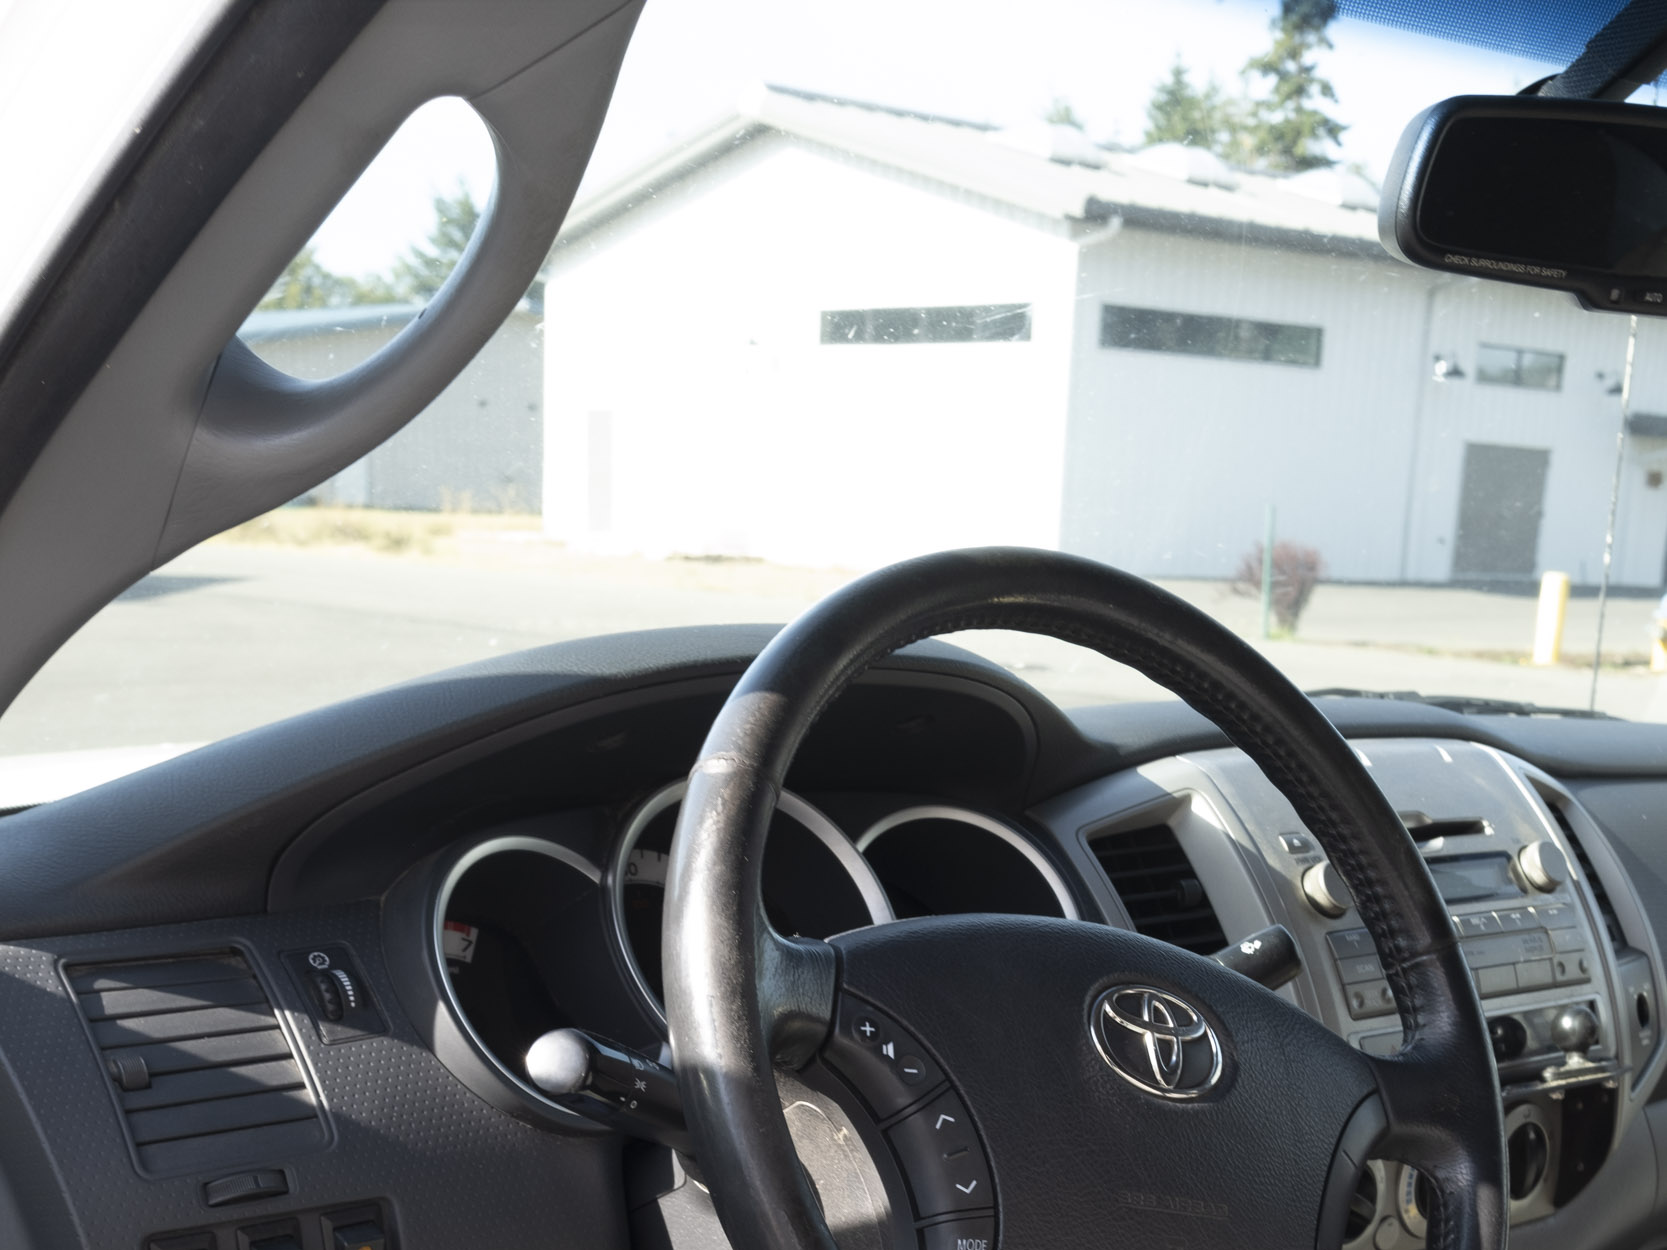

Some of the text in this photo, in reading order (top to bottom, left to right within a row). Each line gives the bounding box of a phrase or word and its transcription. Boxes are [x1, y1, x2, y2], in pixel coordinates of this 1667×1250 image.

[1444, 254, 1567, 279] CHECK SURROUNDINGS FOR SAFETY
[461, 937, 474, 952] 7
